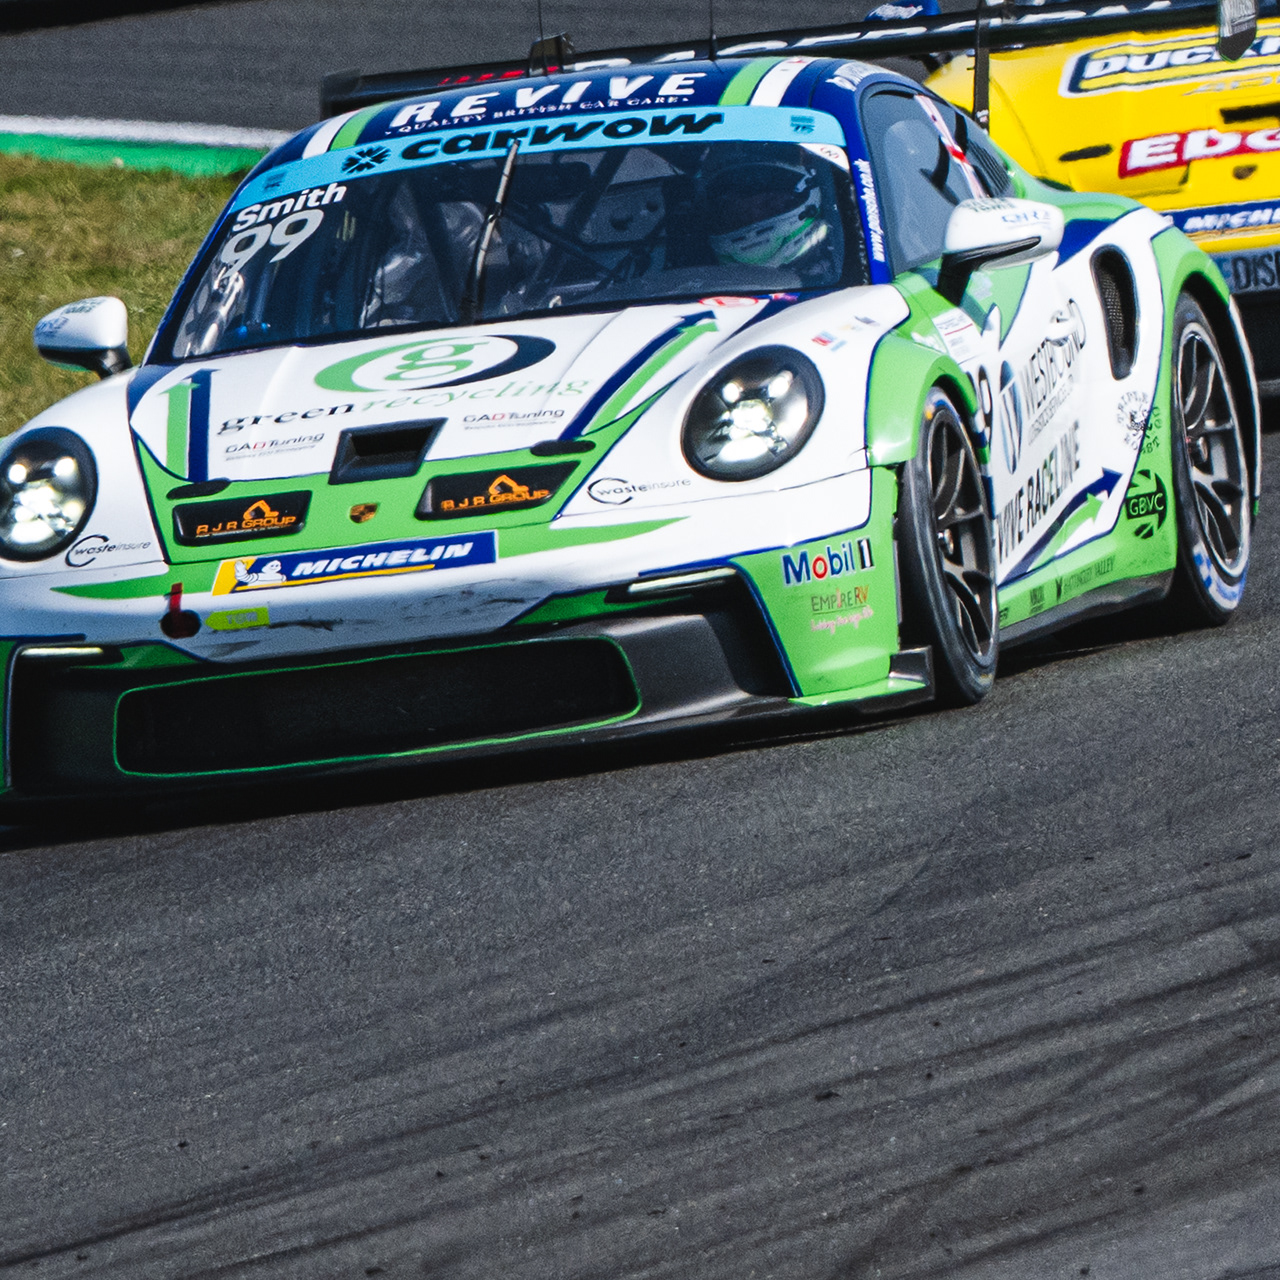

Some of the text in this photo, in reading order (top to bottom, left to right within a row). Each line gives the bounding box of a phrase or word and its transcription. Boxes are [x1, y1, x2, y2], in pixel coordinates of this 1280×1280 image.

[390, 72, 707, 128] REVIVE
[398, 112, 487, 134] QUALITY
[493, 102, 573, 120] BRITISH
[578, 97, 620, 110] CAR
[401, 113, 725, 162] carwow
[232, 182, 348, 233] Smith
[221, 209, 325, 279] 99
[488, 488, 552, 504] GROUP
[1129, 491, 1165, 517] GBVC
[240, 515, 298, 530] GROUP
[291, 541, 475, 578] MICHELIN
[781, 538, 873, 586] Mobil 1
